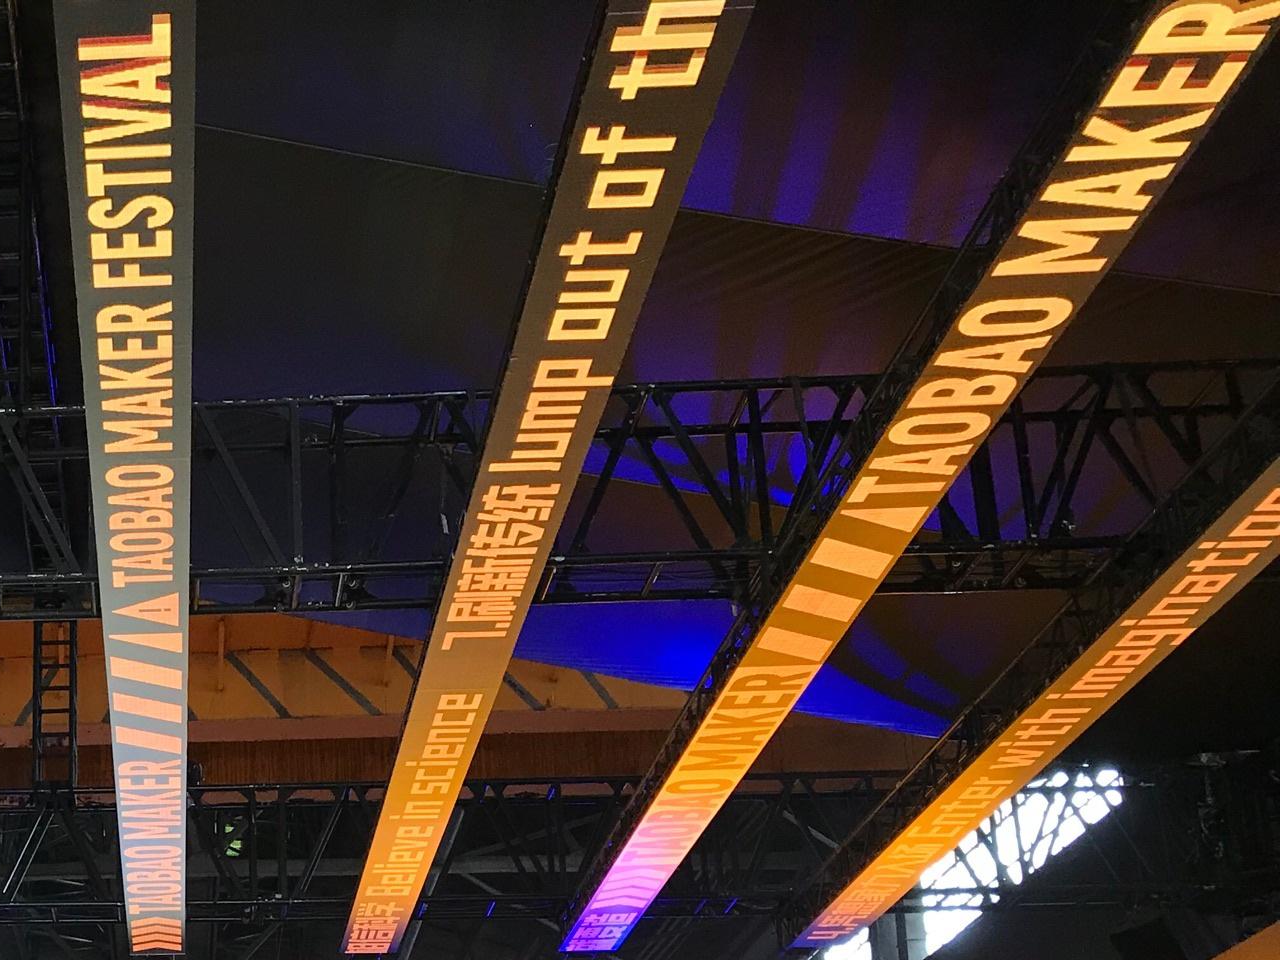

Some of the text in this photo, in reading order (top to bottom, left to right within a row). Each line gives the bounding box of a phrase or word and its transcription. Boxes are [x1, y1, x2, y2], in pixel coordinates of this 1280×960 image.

[580, 125, 677, 210] of
[77, 13, 174, 588] TAOBAO MAKER FESTIVAL
[548, 231, 643, 341] out
[847, 0, 1280, 503] TAOBAO MAKER
[441, 483, 561, 650] 7.刷新传统
[365, 693, 484, 897] Believe in science
[622, 673, 797, 868] TAOBAO MAKER
[928, 776, 1014, 838] Enter
[991, 706, 1093, 767] with
[119, 759, 182, 915] TAOBAO MAKER
[345, 901, 404, 954] 相信科学
